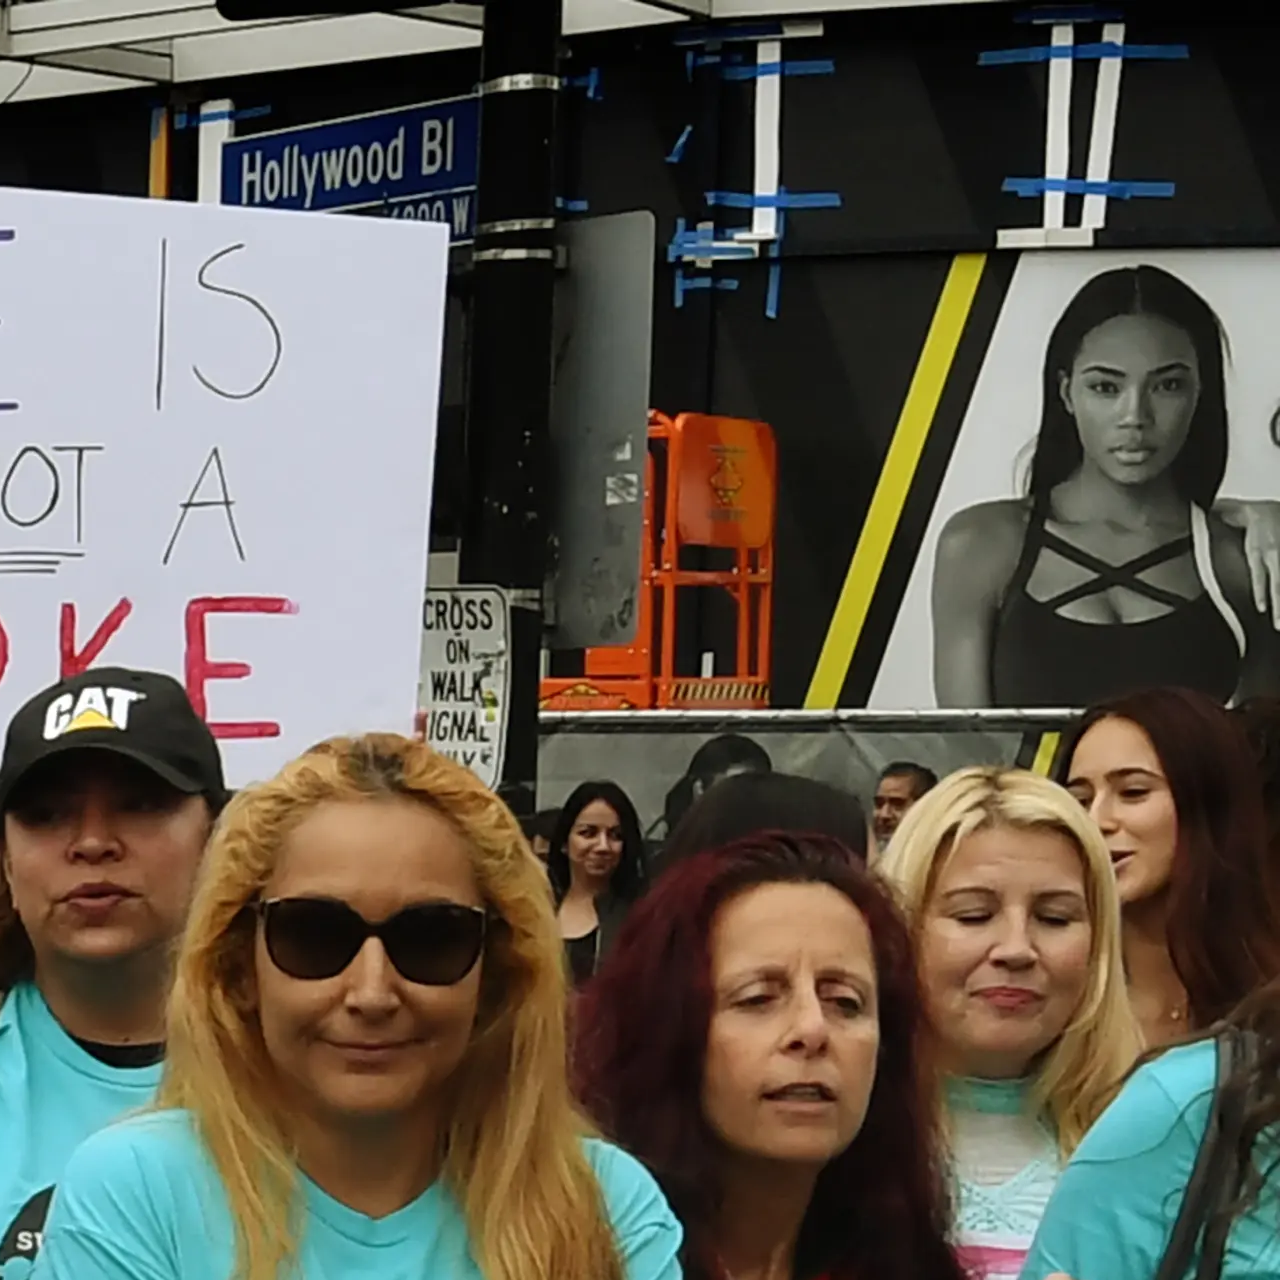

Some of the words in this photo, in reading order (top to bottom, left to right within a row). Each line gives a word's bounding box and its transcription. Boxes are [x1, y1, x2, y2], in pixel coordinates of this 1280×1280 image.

[241, 126, 405, 209] Hollywood
[421, 116, 454, 177] Bl
[154, 237, 283, 410] IS
[163, 446, 245, 566] A
[423, 599, 493, 631] CROSS
[445, 638, 471, 665] ON
[42, 686, 140, 741] CAT
